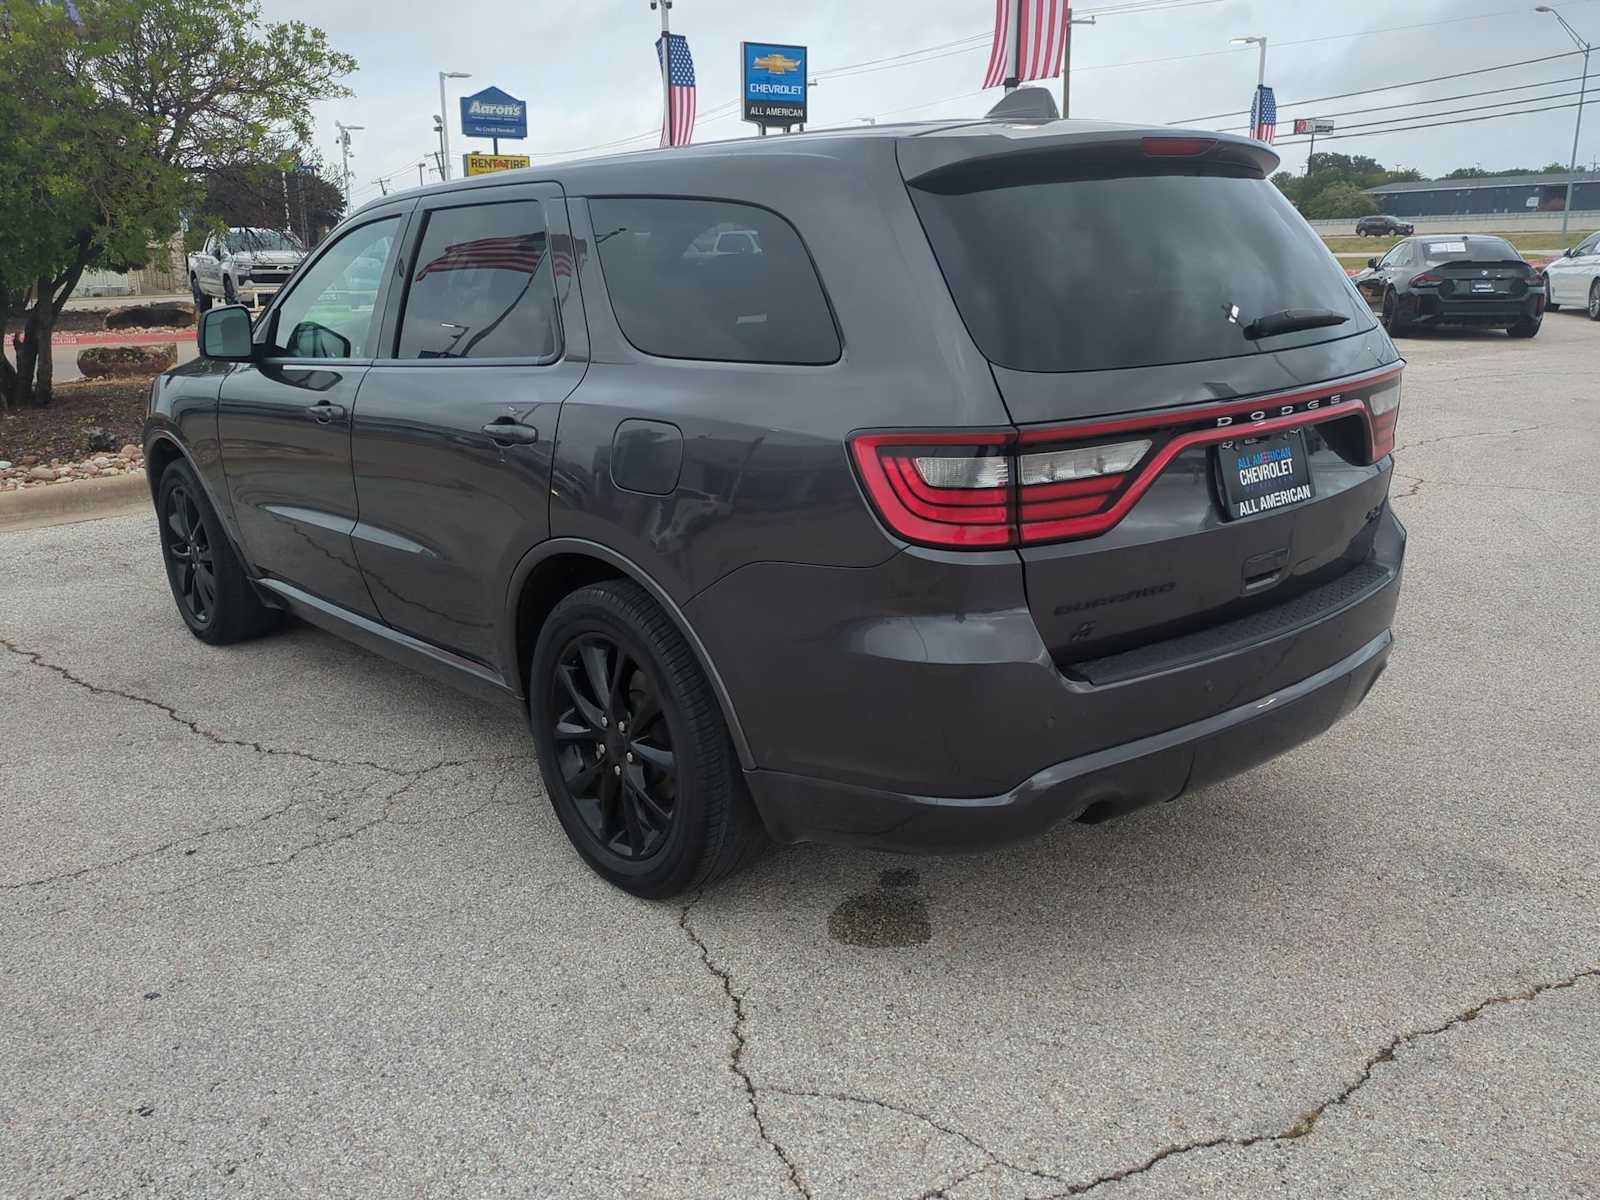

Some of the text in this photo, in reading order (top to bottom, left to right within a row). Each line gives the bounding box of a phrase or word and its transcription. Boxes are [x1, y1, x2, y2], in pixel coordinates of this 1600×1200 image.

[750, 83, 802, 95] CHEVROLET
[469, 100, 521, 115] Aaron's
[750, 106, 804, 117] ALL AMERICAN
[471, 158, 497, 168] RENT
[1217, 394, 1342, 427] DODGE
[1237, 447, 1292, 470] ALL AMERICAN
[1239, 458, 1293, 486] CHEVROLET
[1239, 496, 1260, 517] ALL
[1260, 484, 1311, 511] AMERICAN
